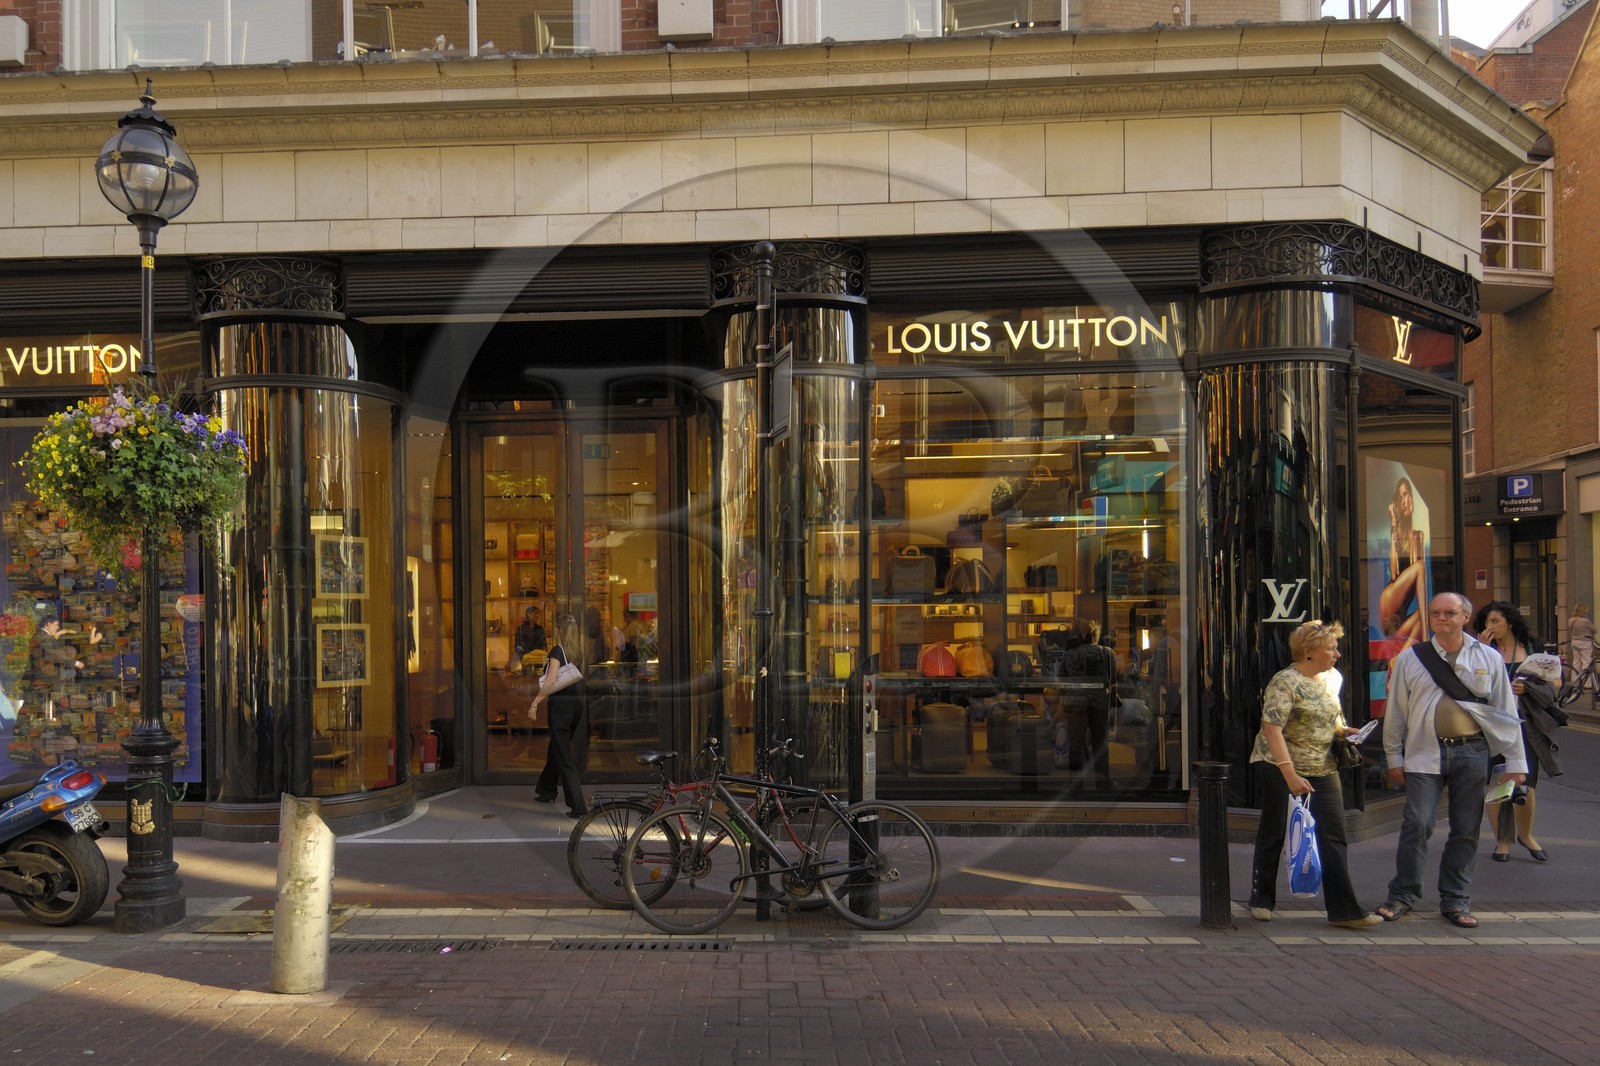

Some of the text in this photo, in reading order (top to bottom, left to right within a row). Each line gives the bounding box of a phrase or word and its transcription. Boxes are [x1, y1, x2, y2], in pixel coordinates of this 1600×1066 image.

[887, 315, 1167, 354] LOUIS VUITTON
[1513, 478, 1529, 495] P
[1500, 497, 1541, 506] Pedestrian
[1503, 505, 1538, 513] Entrance
[73, 809, 84, 820] 99
[84, 804, 91, 812] C
